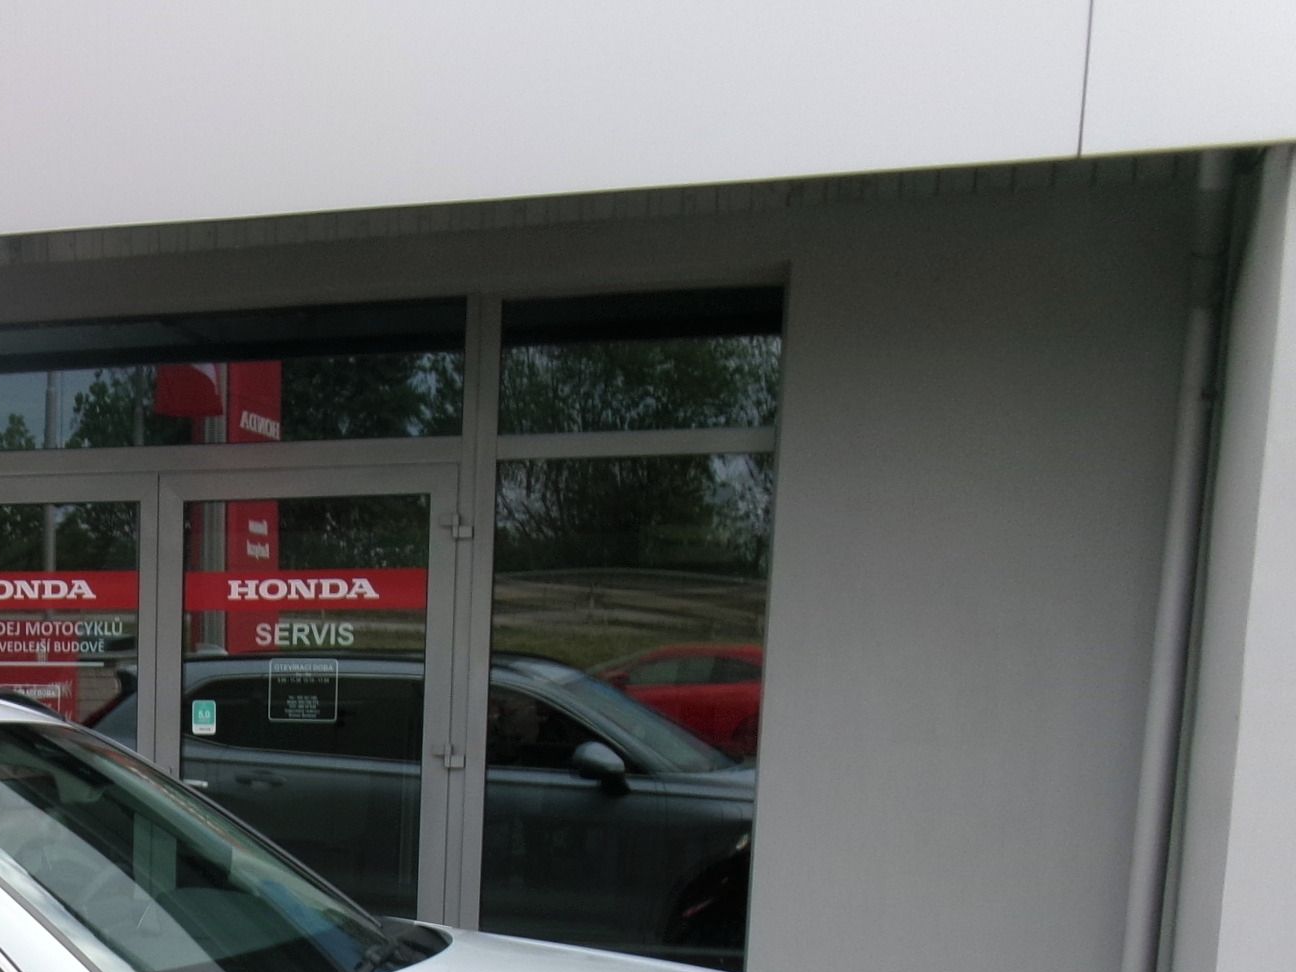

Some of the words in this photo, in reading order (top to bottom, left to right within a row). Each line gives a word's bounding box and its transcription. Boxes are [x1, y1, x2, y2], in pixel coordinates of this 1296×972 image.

[227, 578, 380, 600] HONDA
[25, 617, 123, 637] MOTOCYKLŮ
[255, 623, 355, 647] SERVIS
[0, 638, 51, 653] VEDLEJŠÍ
[55, 638, 105, 653] BUDOVĚ
